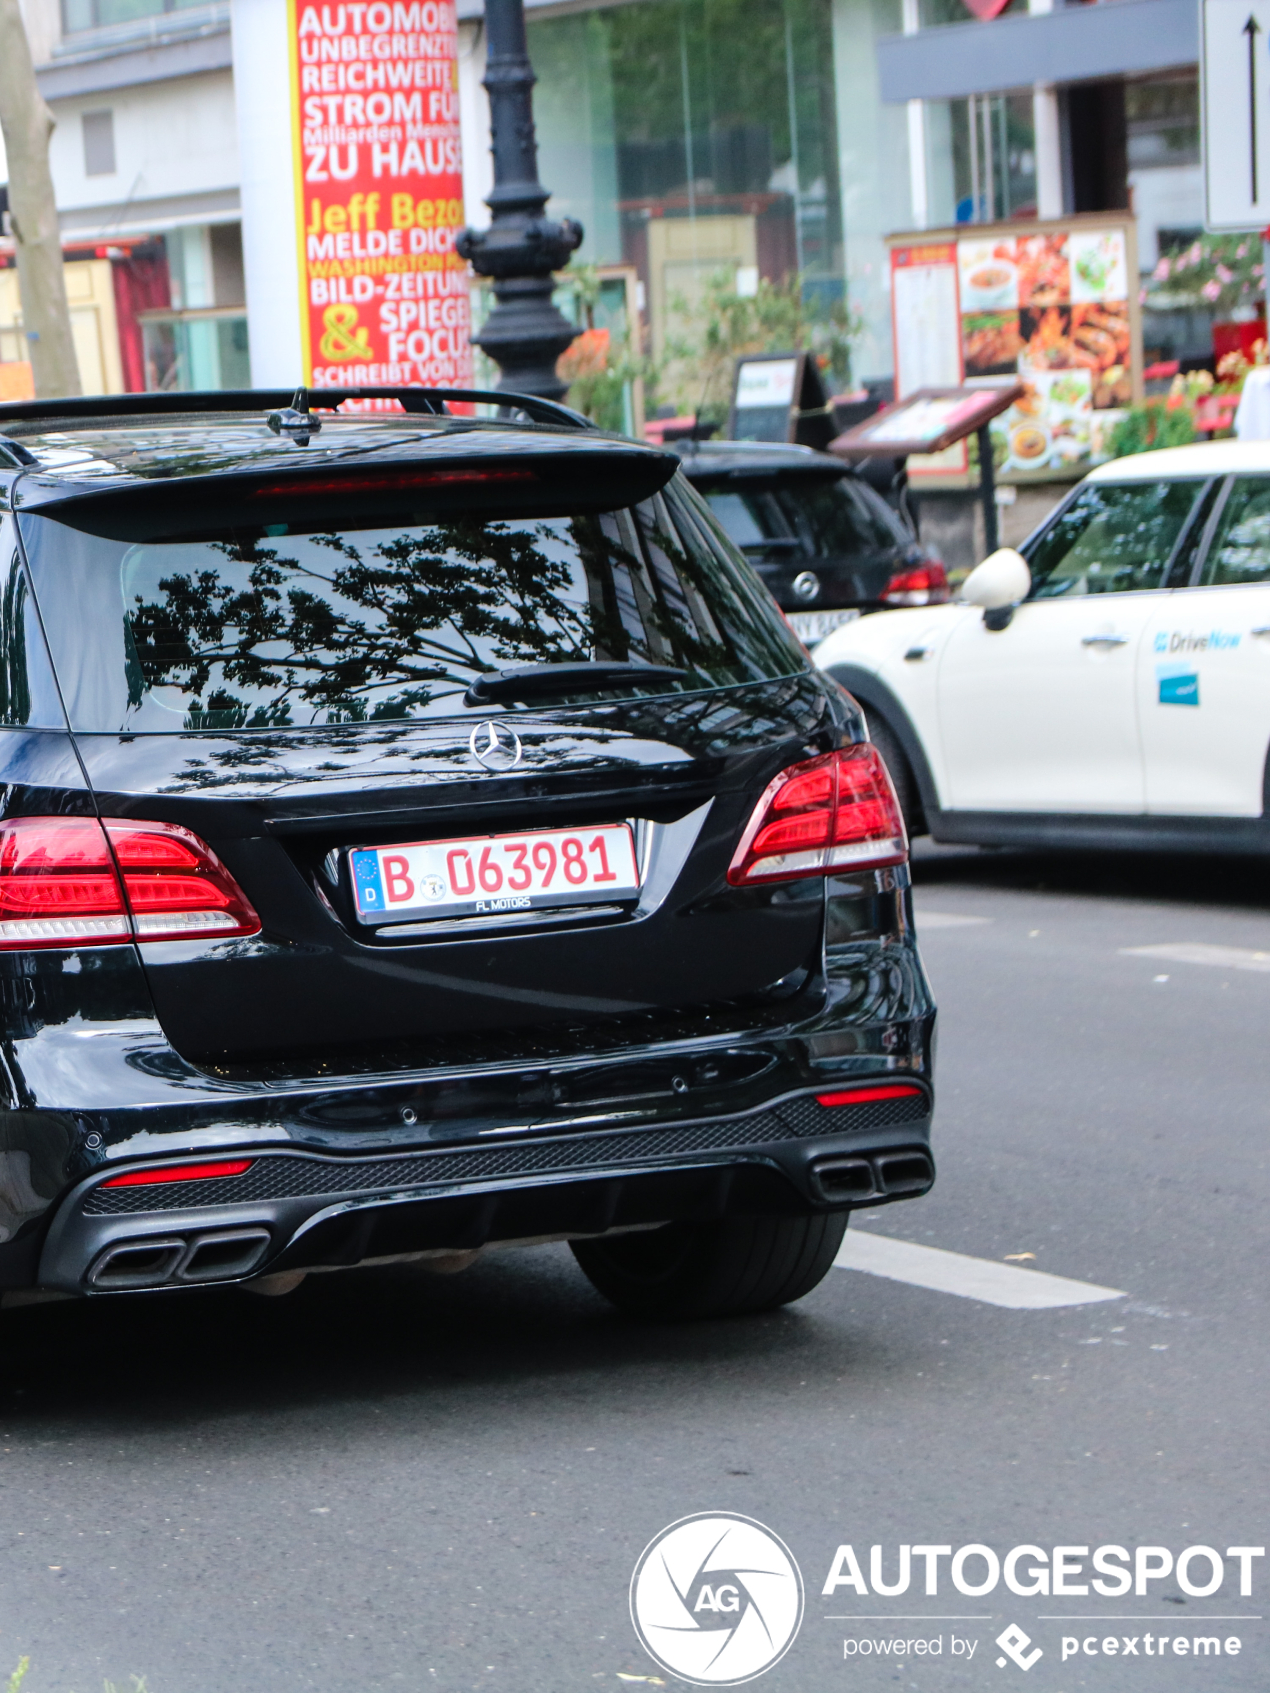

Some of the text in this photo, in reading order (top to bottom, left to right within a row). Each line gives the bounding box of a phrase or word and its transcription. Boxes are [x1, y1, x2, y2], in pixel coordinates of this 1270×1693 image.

[302, 59, 452, 93] REICHWEITE
[303, 91, 423, 127] STROM
[303, 122, 403, 146] Milliarden
[305, 143, 359, 182] ZU
[307, 191, 380, 234] Jeff
[307, 229, 404, 261] MELDE
[308, 252, 442, 278] WASHINGTON
[310, 269, 469, 306] BILD-ZEITUN
[319, 303, 374, 362] &
[312, 361, 414, 388] SCHREIBT
[416, 357, 455, 381] VON
[1170, 629, 1242, 653] DriveNow
[382, 855, 415, 903] B
[446, 834, 618, 896] 063981
[365, 887, 377, 901] D
[476, 896, 532, 911] FL MOTORS
